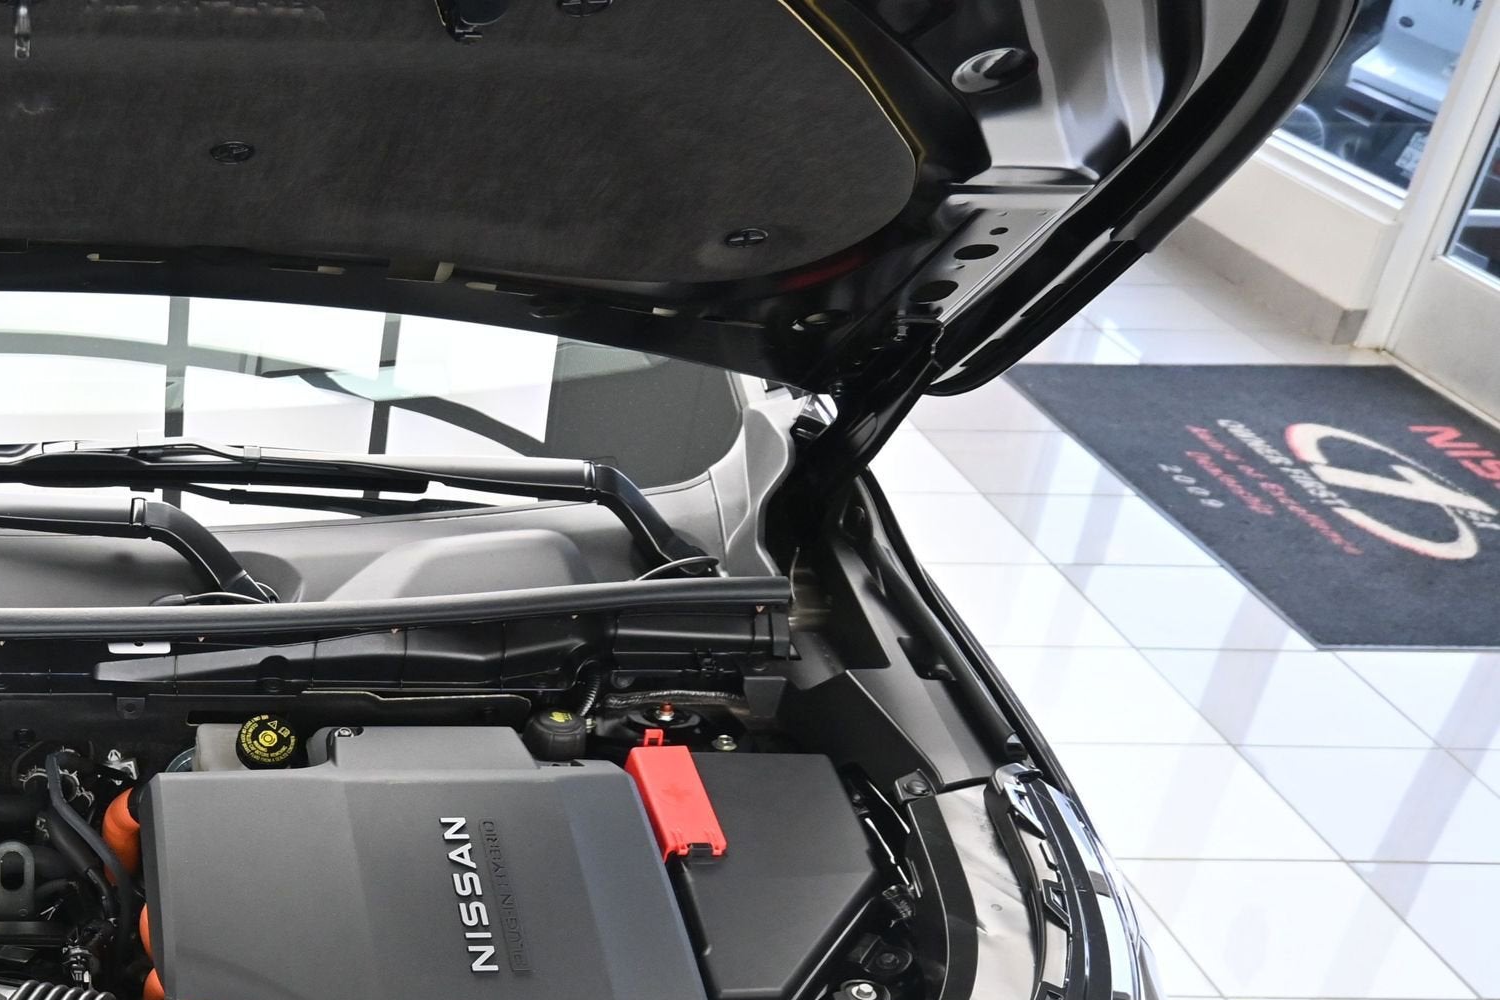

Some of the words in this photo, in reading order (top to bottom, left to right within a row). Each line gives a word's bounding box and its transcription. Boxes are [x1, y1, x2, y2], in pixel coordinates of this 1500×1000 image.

[1279, 466, 1350, 508] FIRST
[1408, 425, 1500, 489] NIS
[482, 821, 509, 886] HYBRID
[440, 817, 499, 972] NISSAN
[501, 893, 528, 967] PLUG-IN
